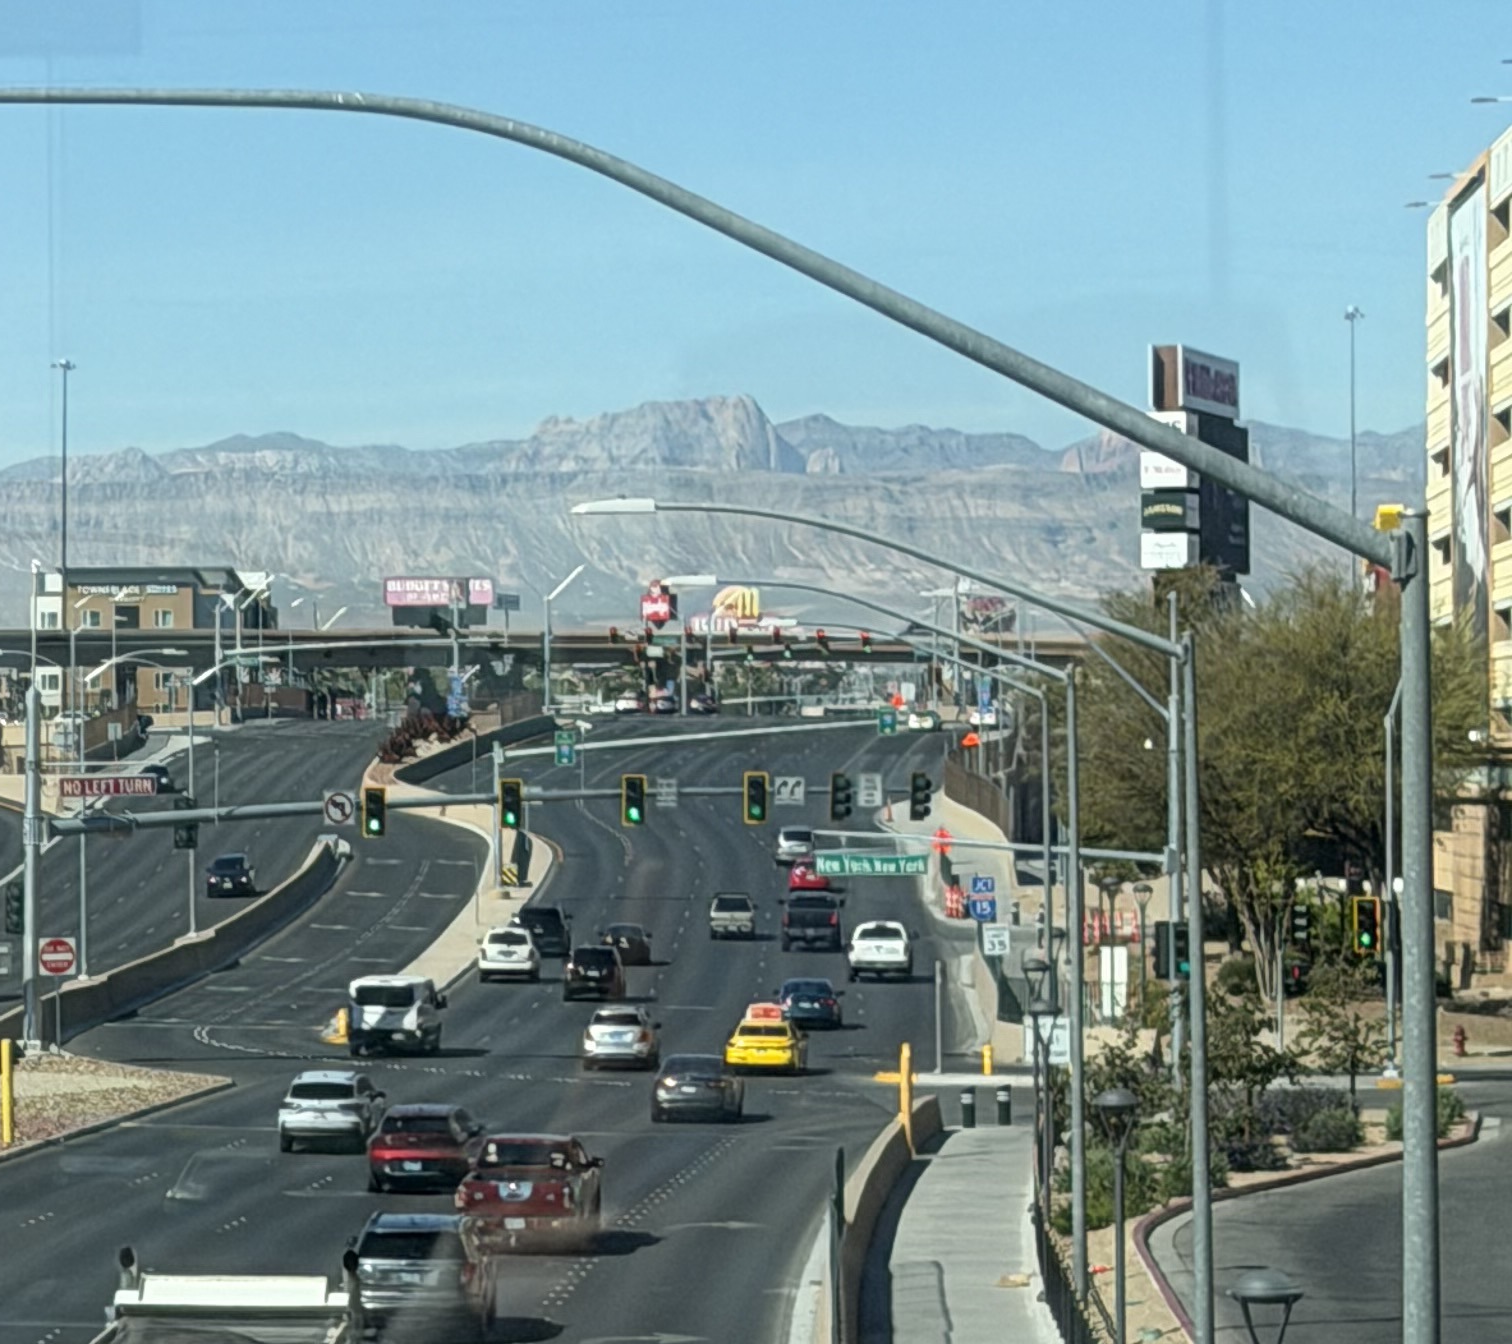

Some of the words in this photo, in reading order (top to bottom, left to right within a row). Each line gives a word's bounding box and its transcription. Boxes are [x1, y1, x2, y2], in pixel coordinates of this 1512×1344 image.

[63, 780, 83, 795] NO
[84, 778, 115, 795] LEFT
[118, 777, 153, 794] TURN
[974, 879, 993, 892] JCT
[976, 901, 991, 914] 15
[988, 940, 1007, 952] 35
